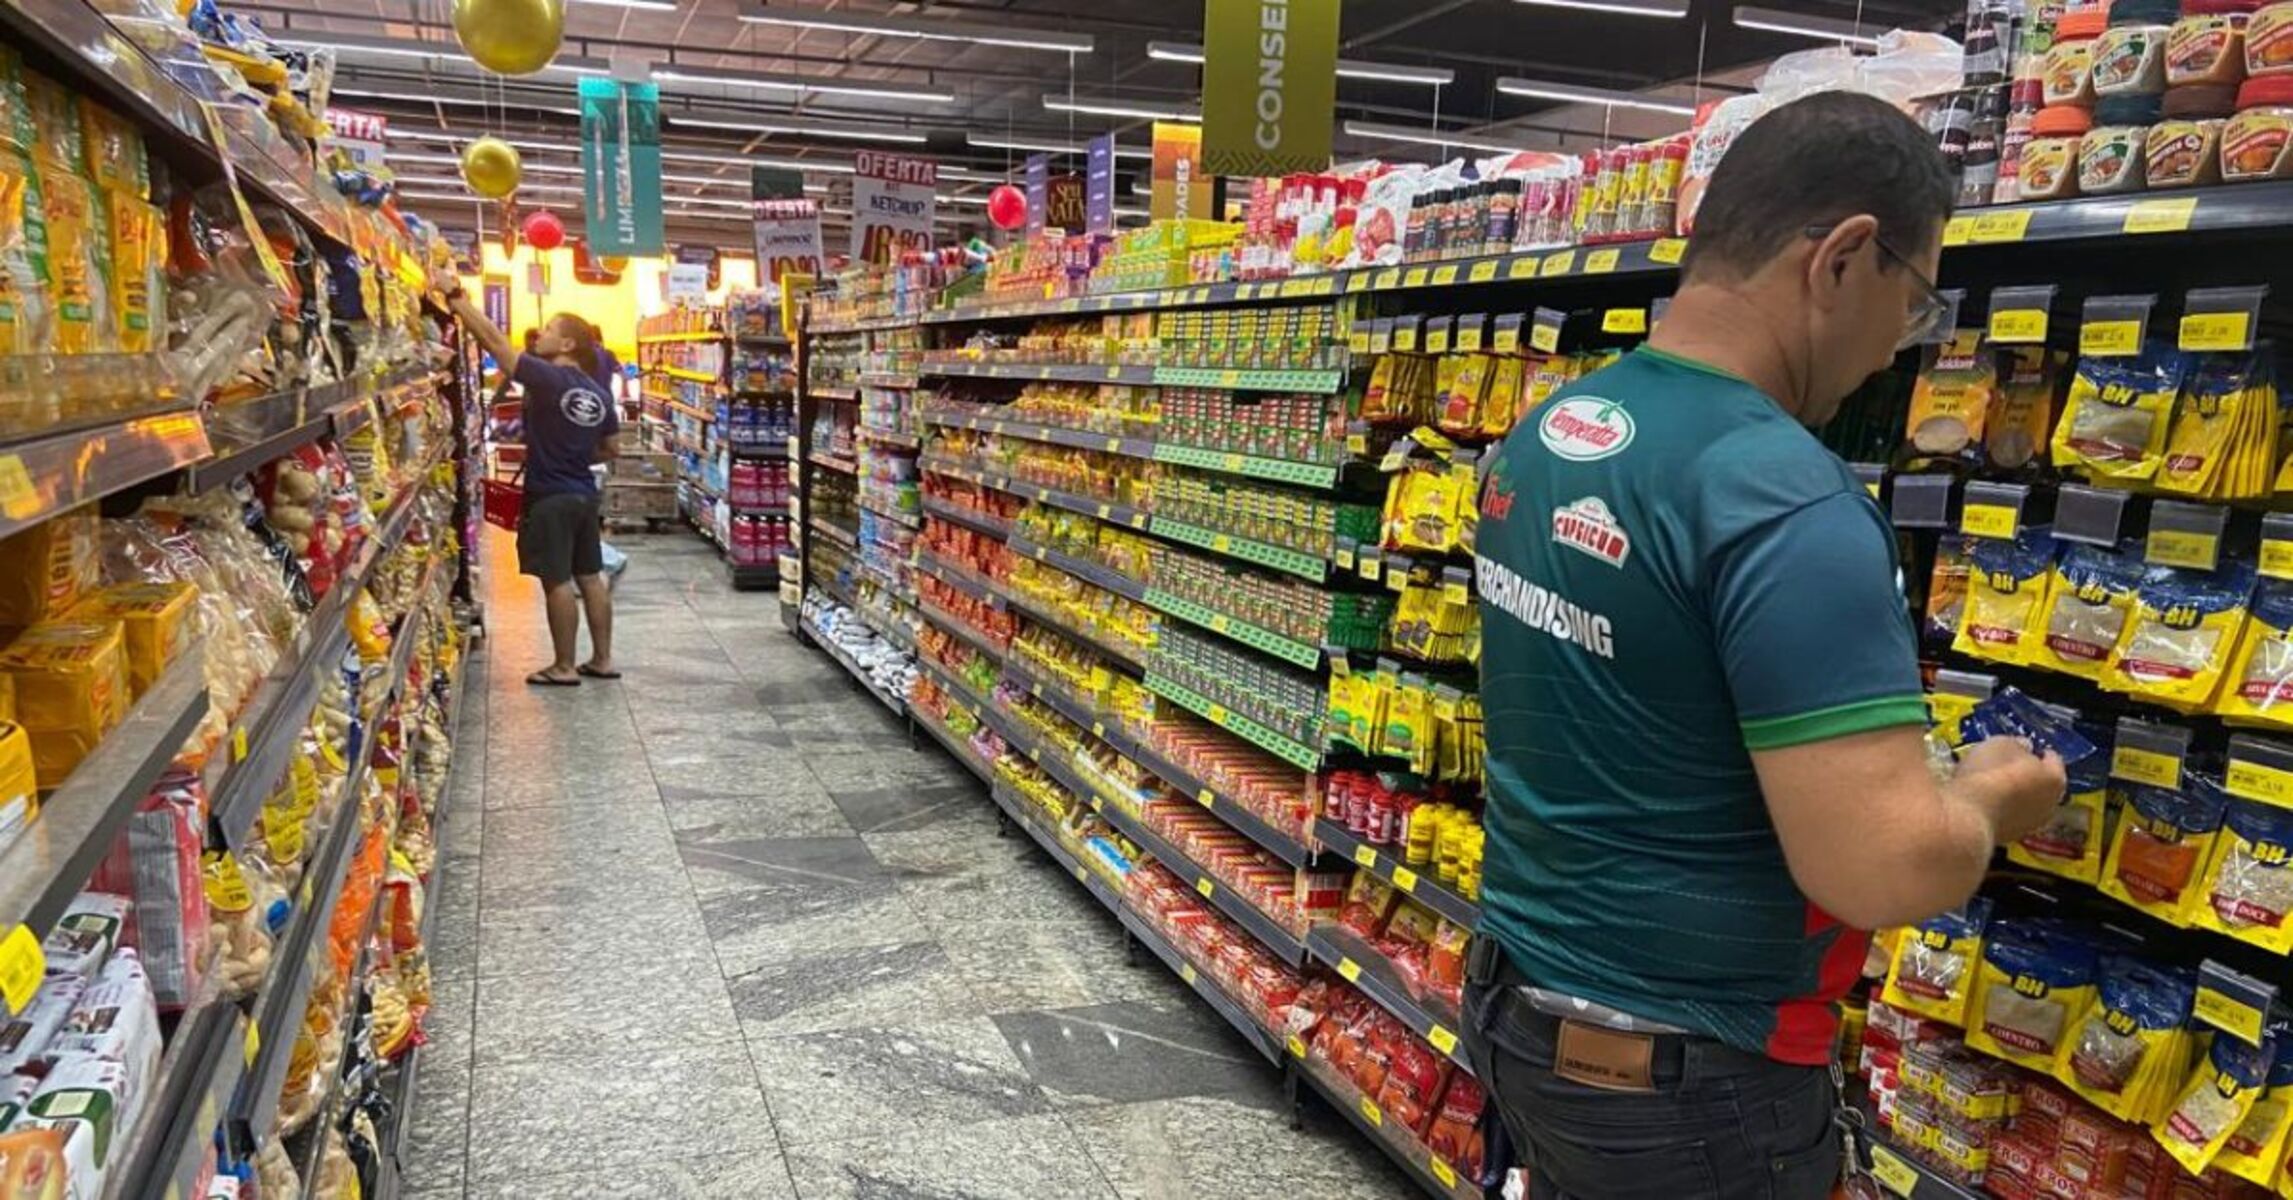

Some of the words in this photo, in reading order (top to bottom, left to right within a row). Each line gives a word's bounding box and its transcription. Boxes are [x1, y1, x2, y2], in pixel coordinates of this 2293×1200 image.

[1255, 0, 1288, 151] CONSE
[856, 151, 935, 185] OFERTA
[754, 200, 818, 220] OFERTA
[2103, 384, 2135, 406] BH
[1993, 571, 2014, 592] BH
[1474, 553, 1616, 660] ERCHANDISING
[2164, 606, 2199, 627] BH
[2252, 842, 2287, 864] BH
[2014, 975, 2046, 997] BH
[2107, 1011, 2136, 1034] BH
